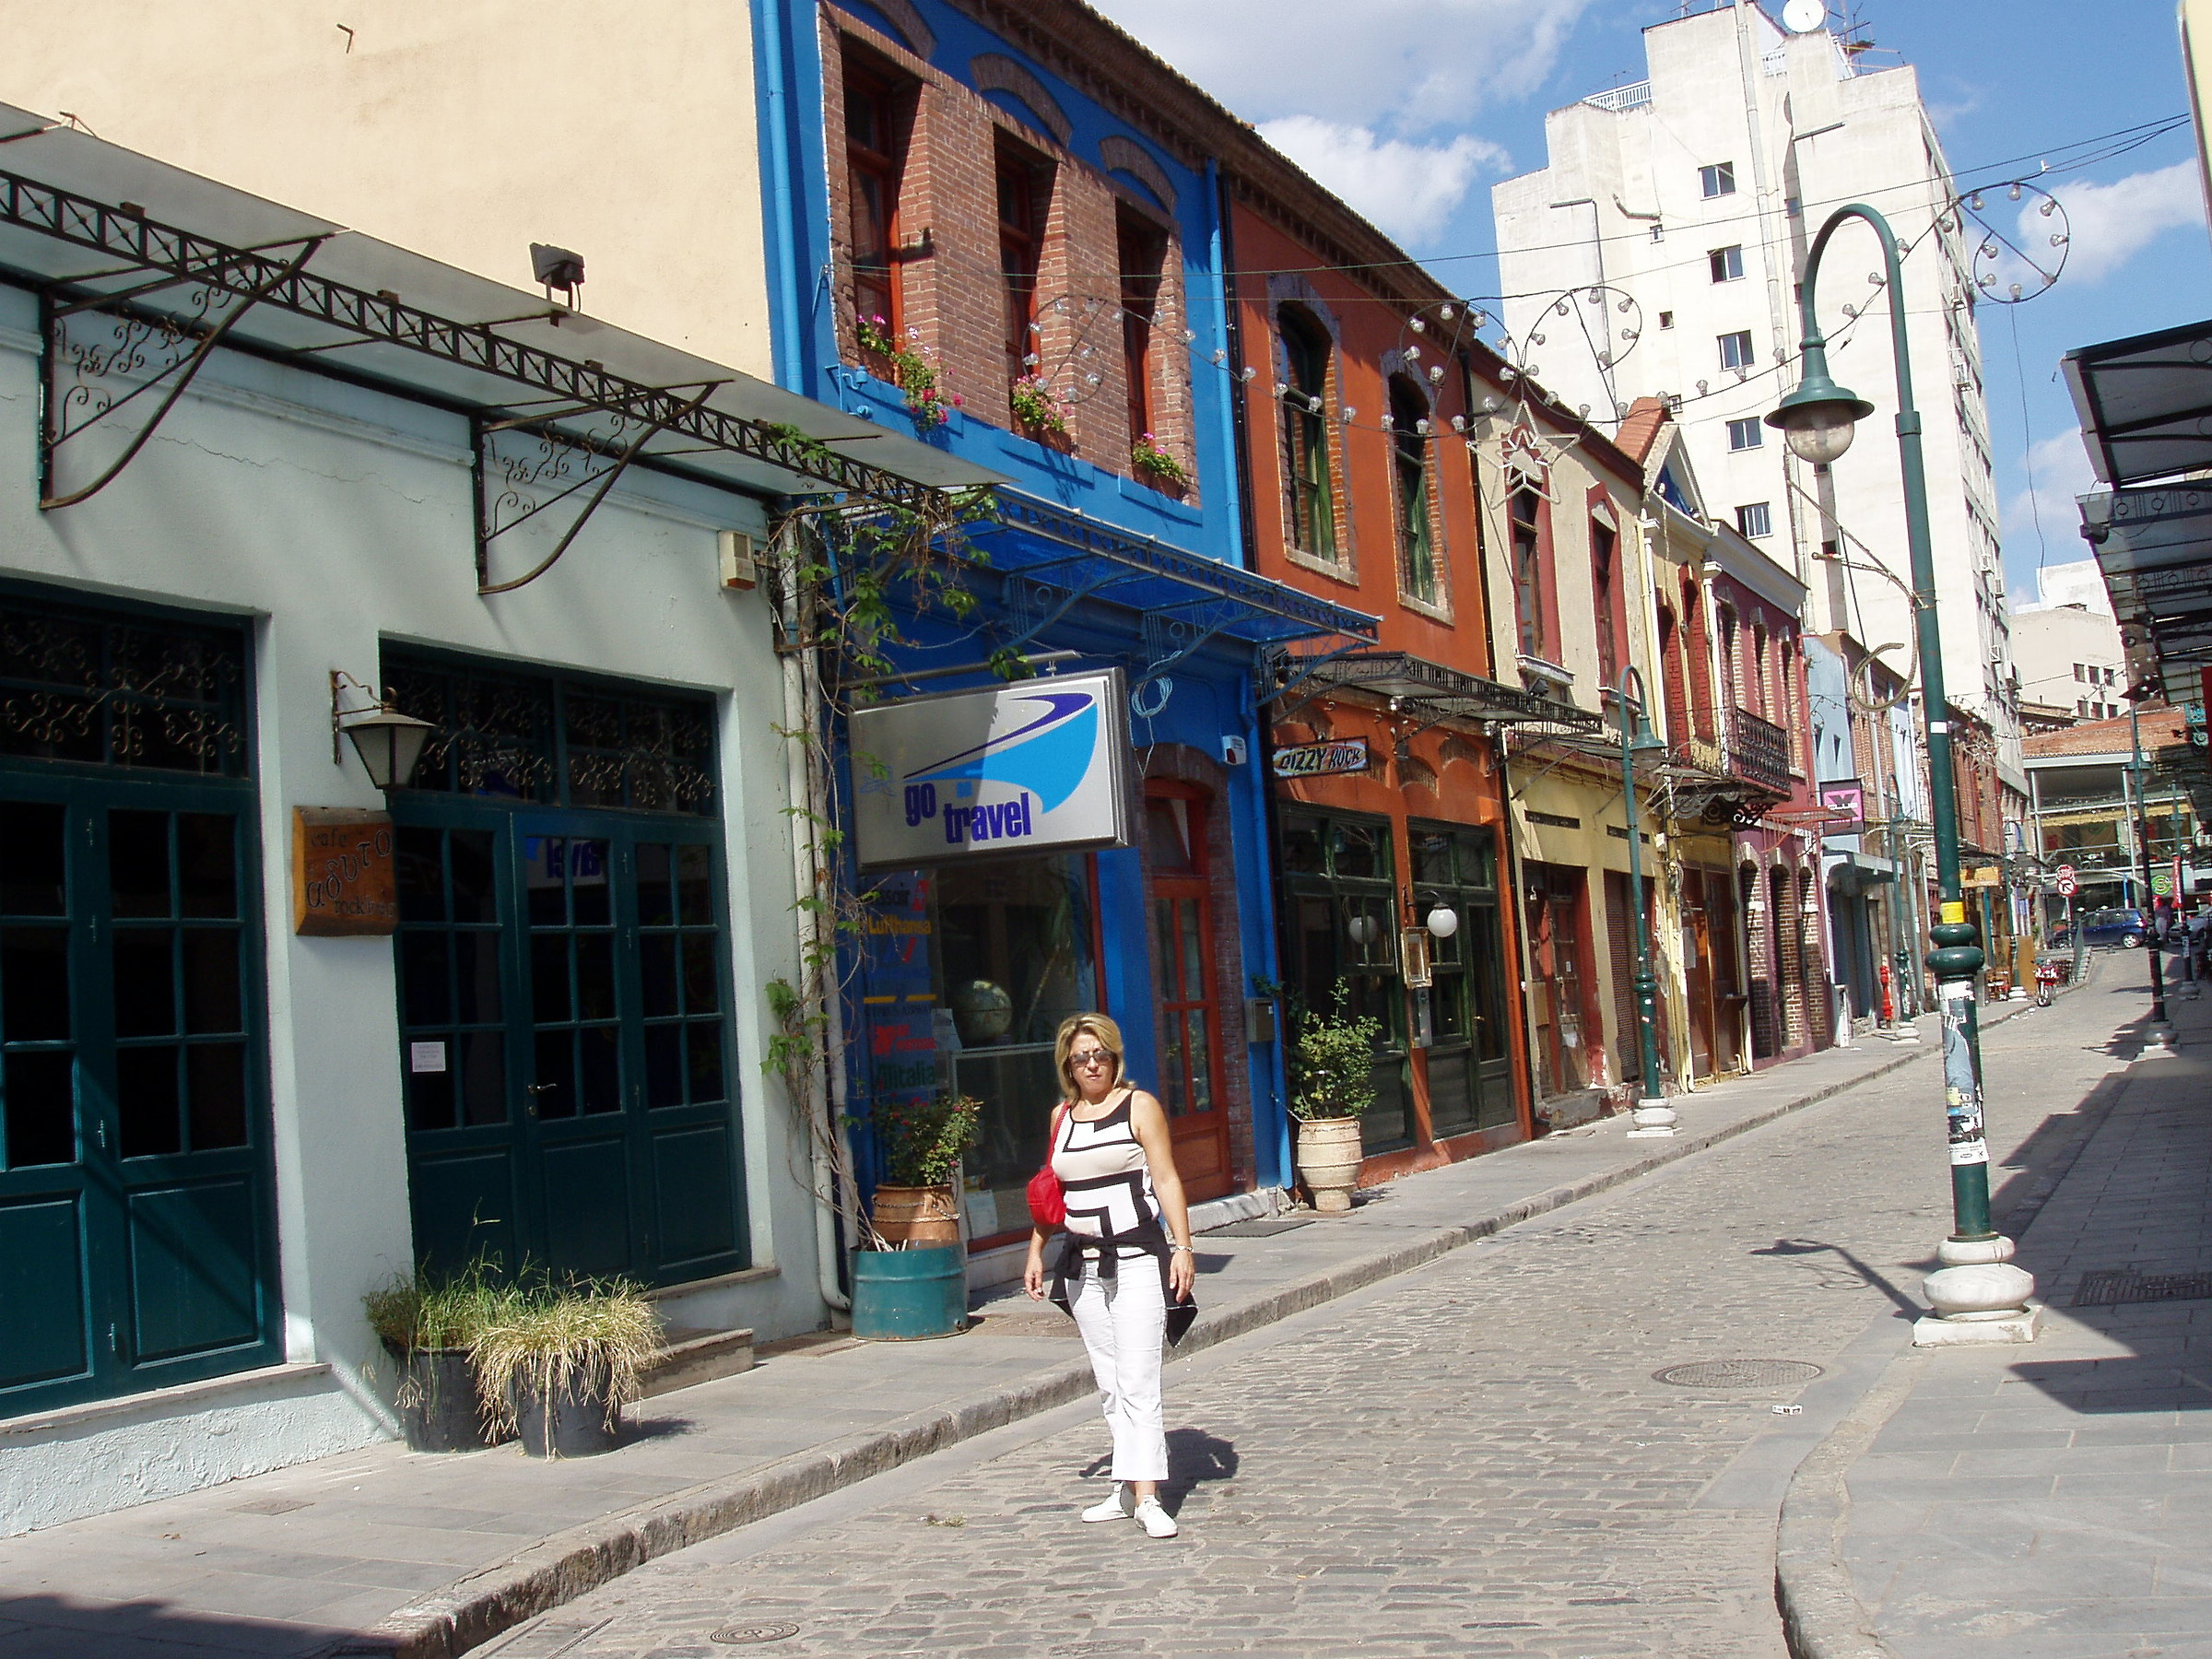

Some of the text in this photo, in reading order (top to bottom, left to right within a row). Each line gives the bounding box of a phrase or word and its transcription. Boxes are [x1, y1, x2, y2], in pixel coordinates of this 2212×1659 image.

[1280, 747, 1360, 771] DIZZY ROCK
[904, 782, 937, 828] go
[943, 793, 1032, 844] travel
[334, 896, 365, 914] rock
